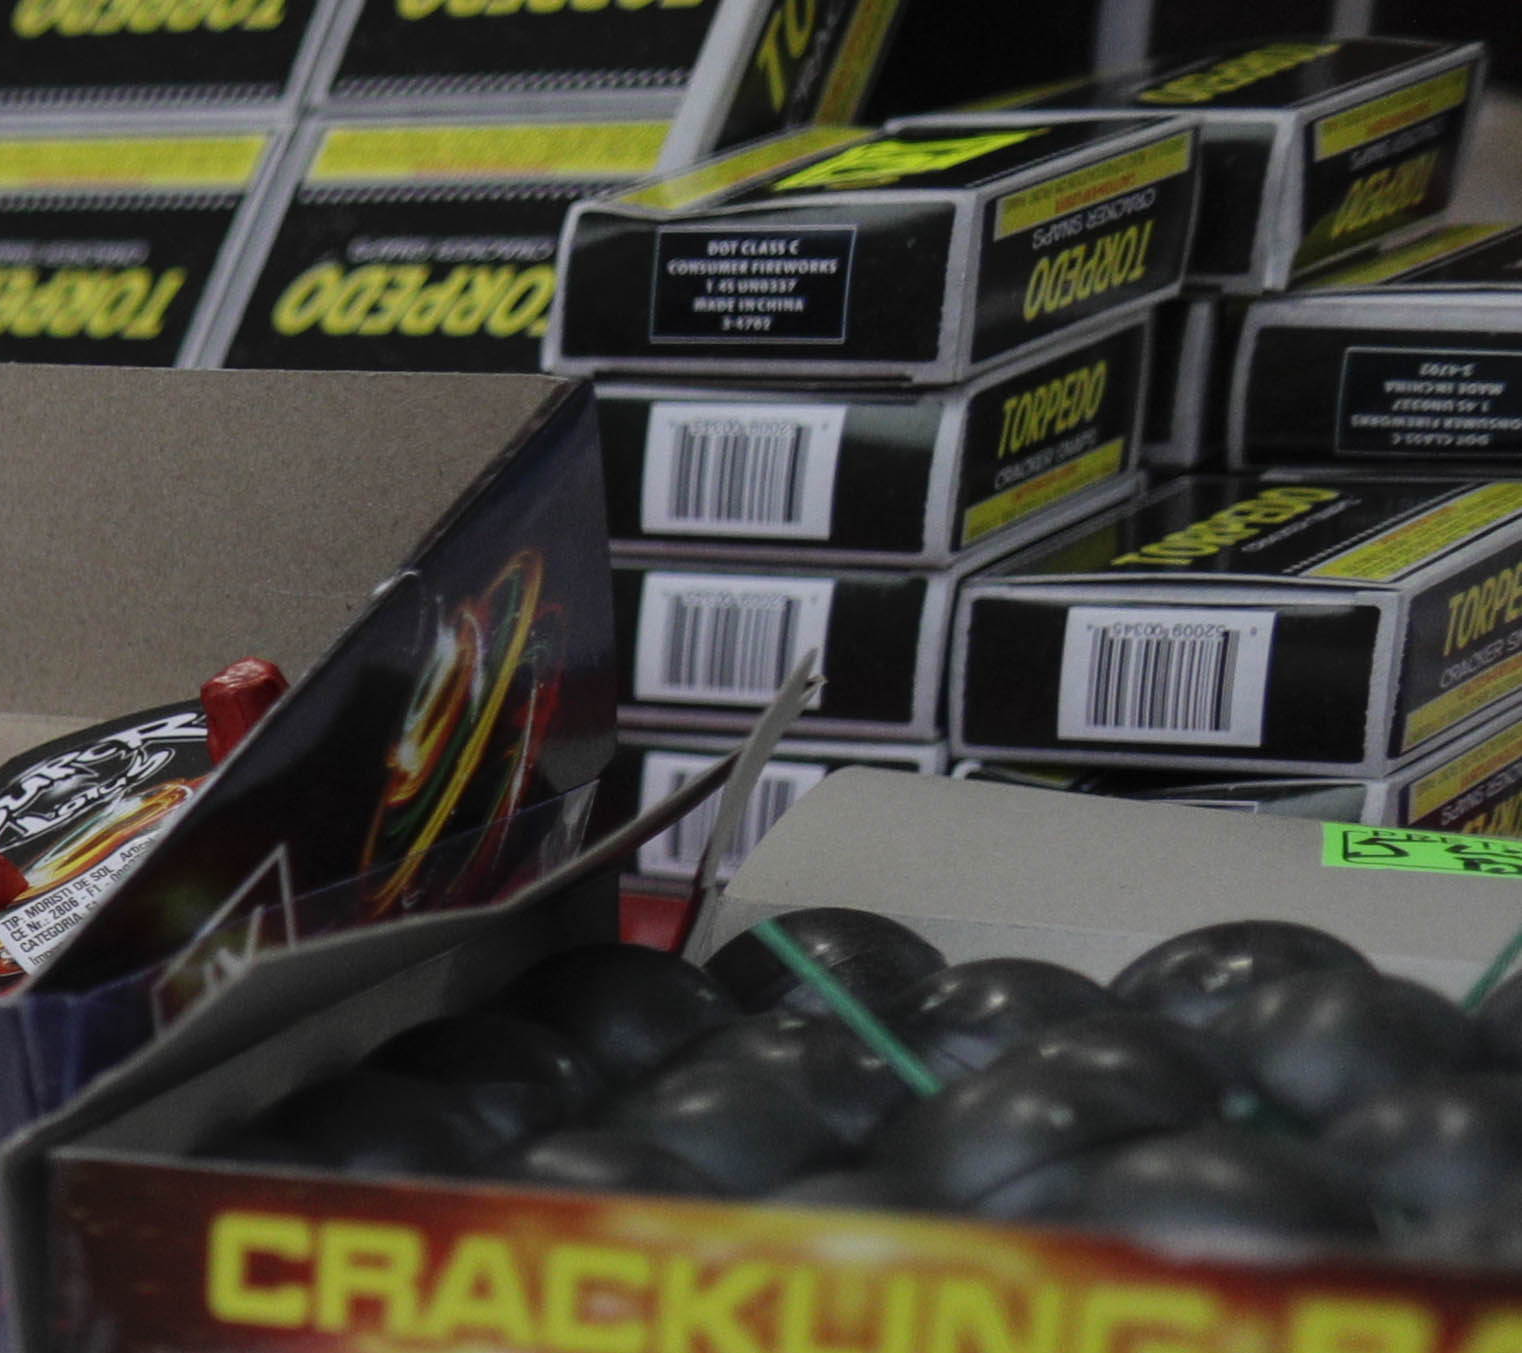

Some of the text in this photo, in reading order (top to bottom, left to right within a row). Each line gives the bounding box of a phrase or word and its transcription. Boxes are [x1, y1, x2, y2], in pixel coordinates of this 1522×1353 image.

[741, 240, 785, 255] CLASS
[667, 258, 838, 274] CONSUMER FIREWORKS
[1024, 219, 1155, 321] TORPEDO
[272, 264, 557, 336] ORPEDO
[693, 297, 803, 312] MADE IN CHINA
[999, 360, 1107, 458] TORPEDO
[23, 884, 73, 920] MORISTI
[49, 896, 79, 920] 2806
